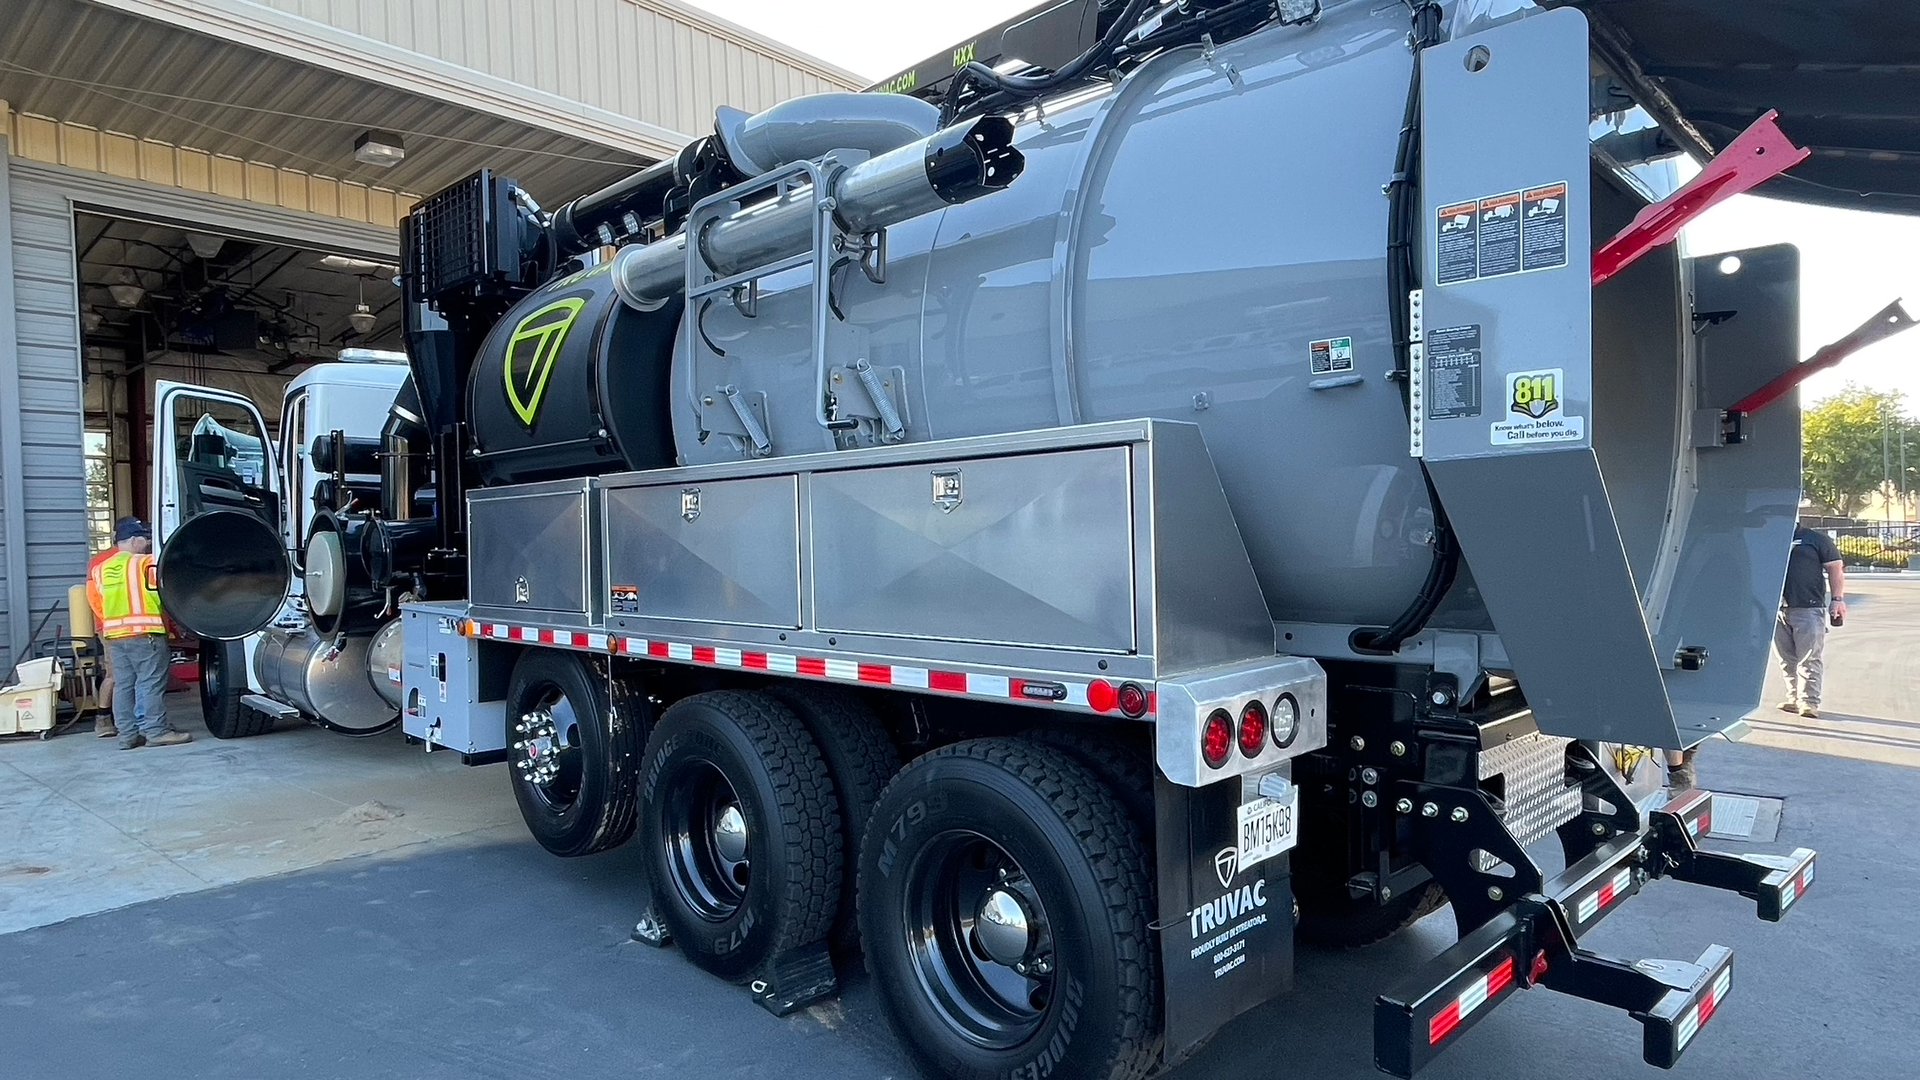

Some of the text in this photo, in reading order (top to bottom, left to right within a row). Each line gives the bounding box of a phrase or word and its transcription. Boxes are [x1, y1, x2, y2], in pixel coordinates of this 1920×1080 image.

[952, 42, 975, 67] HXX
[1514, 375, 1554, 404] 811
[1507, 431, 1525, 440] Call
[1526, 431, 1549, 439] before
[1565, 429, 1578, 438] dig.
[1536, 420, 1564, 428] below.
[1243, 806, 1291, 853] BM15K98
[1187, 879, 1267, 939] TRUVAC
[1190, 938, 1216, 959] PROUDLY
[1215, 930, 1230, 945] BUILT
[1229, 927, 1236, 938] IN
[1214, 954, 1246, 979] TRUVAC.COM
